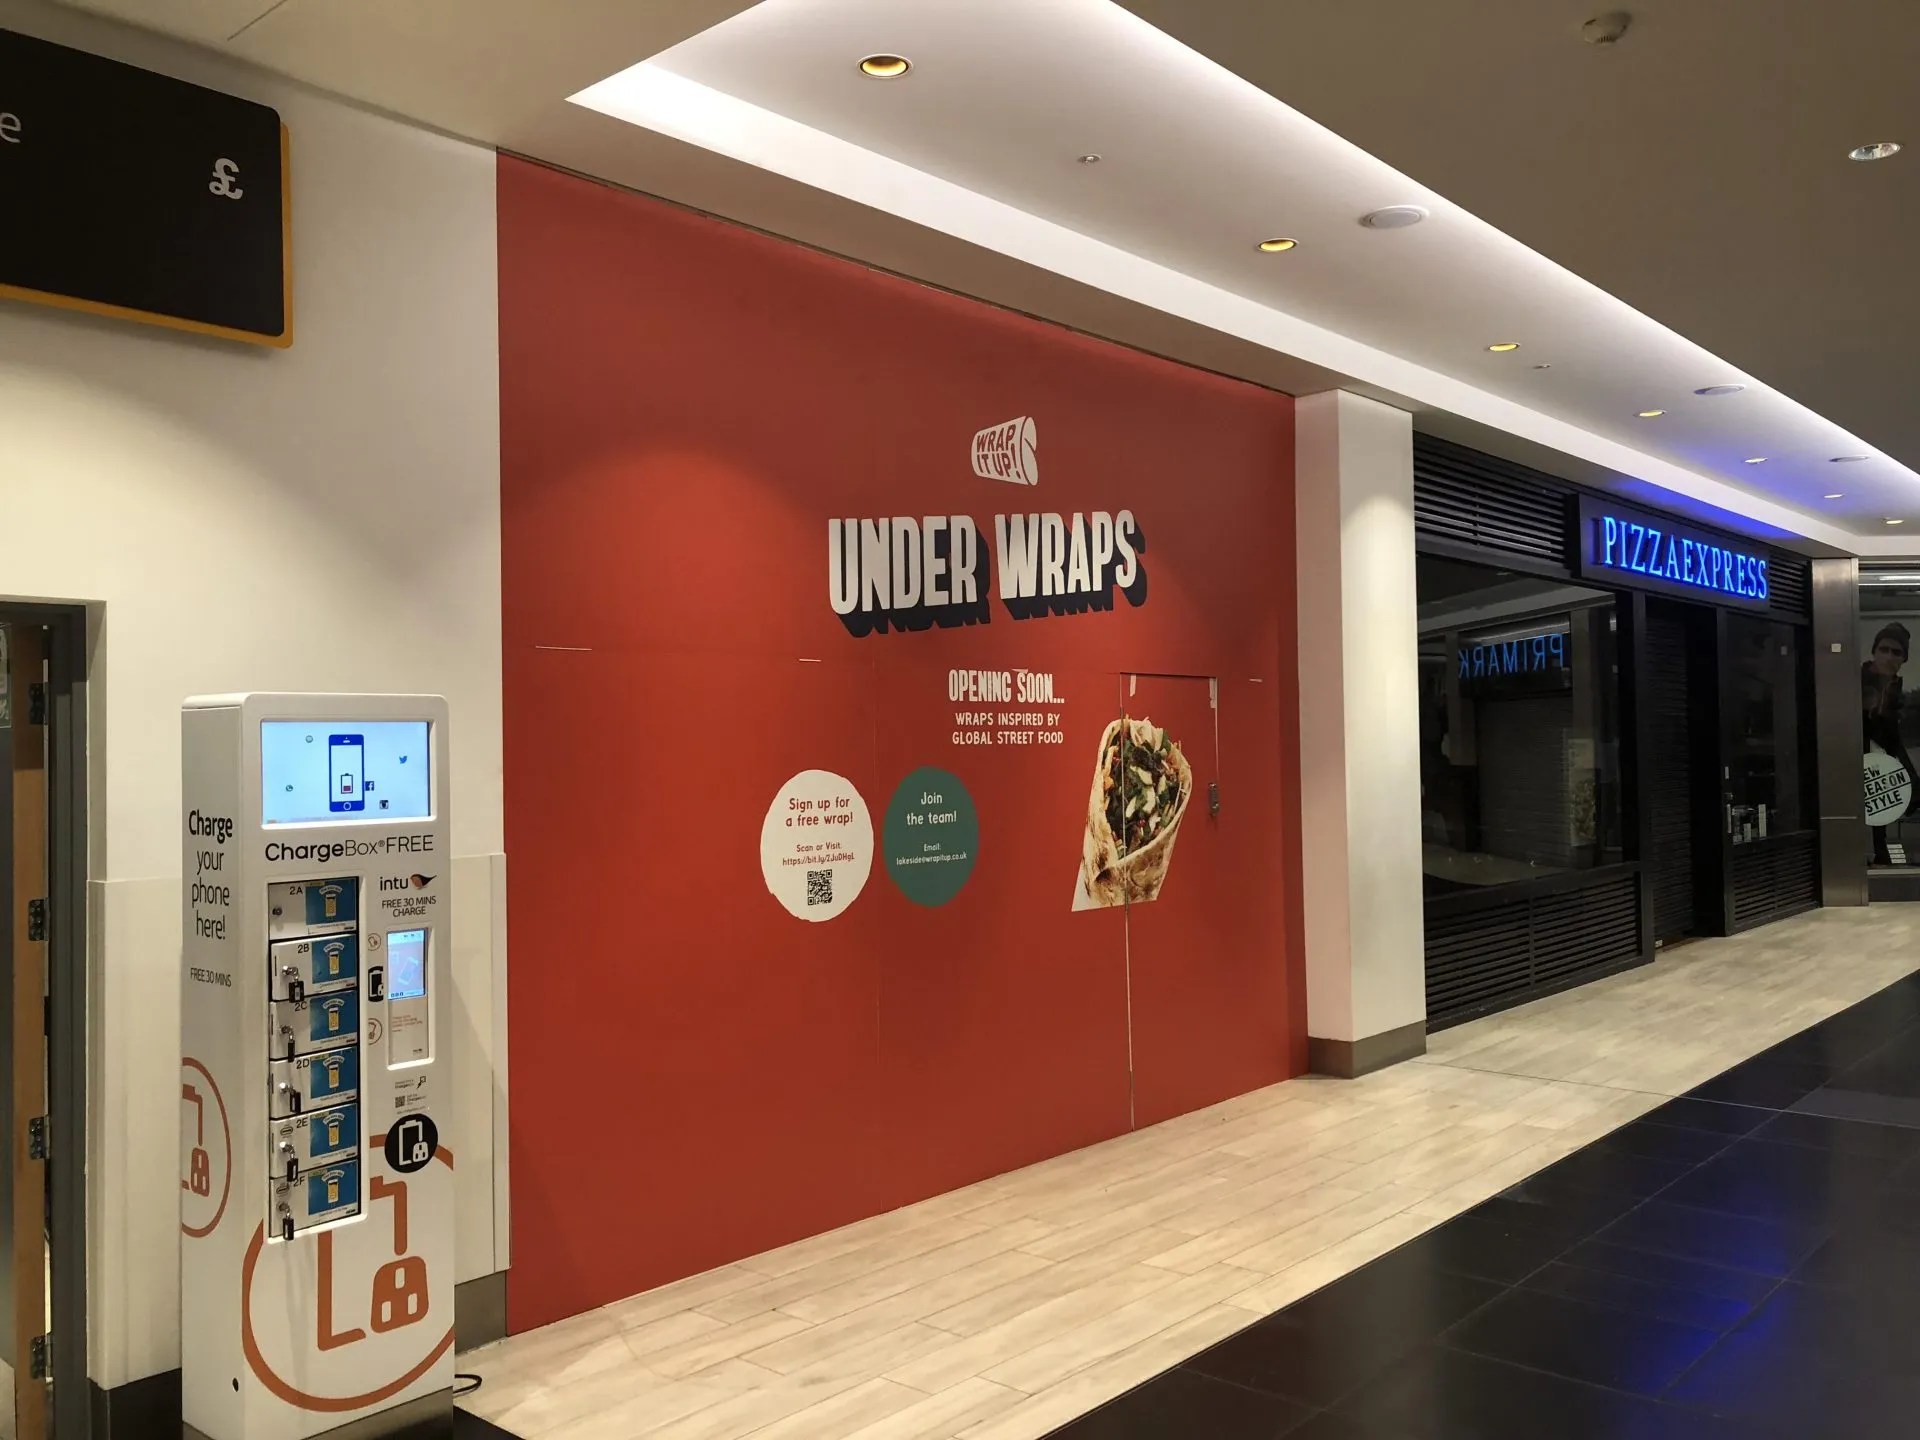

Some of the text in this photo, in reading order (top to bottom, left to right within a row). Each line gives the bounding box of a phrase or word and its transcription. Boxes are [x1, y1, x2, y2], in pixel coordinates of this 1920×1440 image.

[976, 423, 1017, 453] WRAP
[976, 442, 1021, 480] IT UP!
[828, 509, 1137, 615] UNDER WRAPS
[1603, 516, 1768, 599] PIZZAEXPRESS
[948, 669, 1065, 704] OPENING SOON...
[955, 712, 1061, 726] WRAPS INSPIRED BY
[952, 731, 1064, 745] GLOBAL STREET FOOD
[789, 796, 850, 813] Sign up for
[920, 791, 943, 805] Join
[1865, 789, 1903, 813] STYLE
[785, 811, 853, 828] a free wrap!
[906, 809, 957, 826] the team!
[188, 808, 233, 844] Charge
[796, 844, 814, 853] Scan
[196, 850, 224, 876] your
[289, 886, 303, 896] 2A
[379, 876, 409, 891] intu
[191, 876, 230, 909] phone
[381, 895, 437, 909] FREE 30 MINS
[392, 905, 426, 918] CHARGE
[196, 909, 226, 940] here!
[297, 943, 310, 954] 2B
[190, 967, 205, 983] FREE
[294, 1001, 308, 1012] 2C
[296, 1058, 310, 1069] 2D
[295, 1117, 309, 1129] 2E
